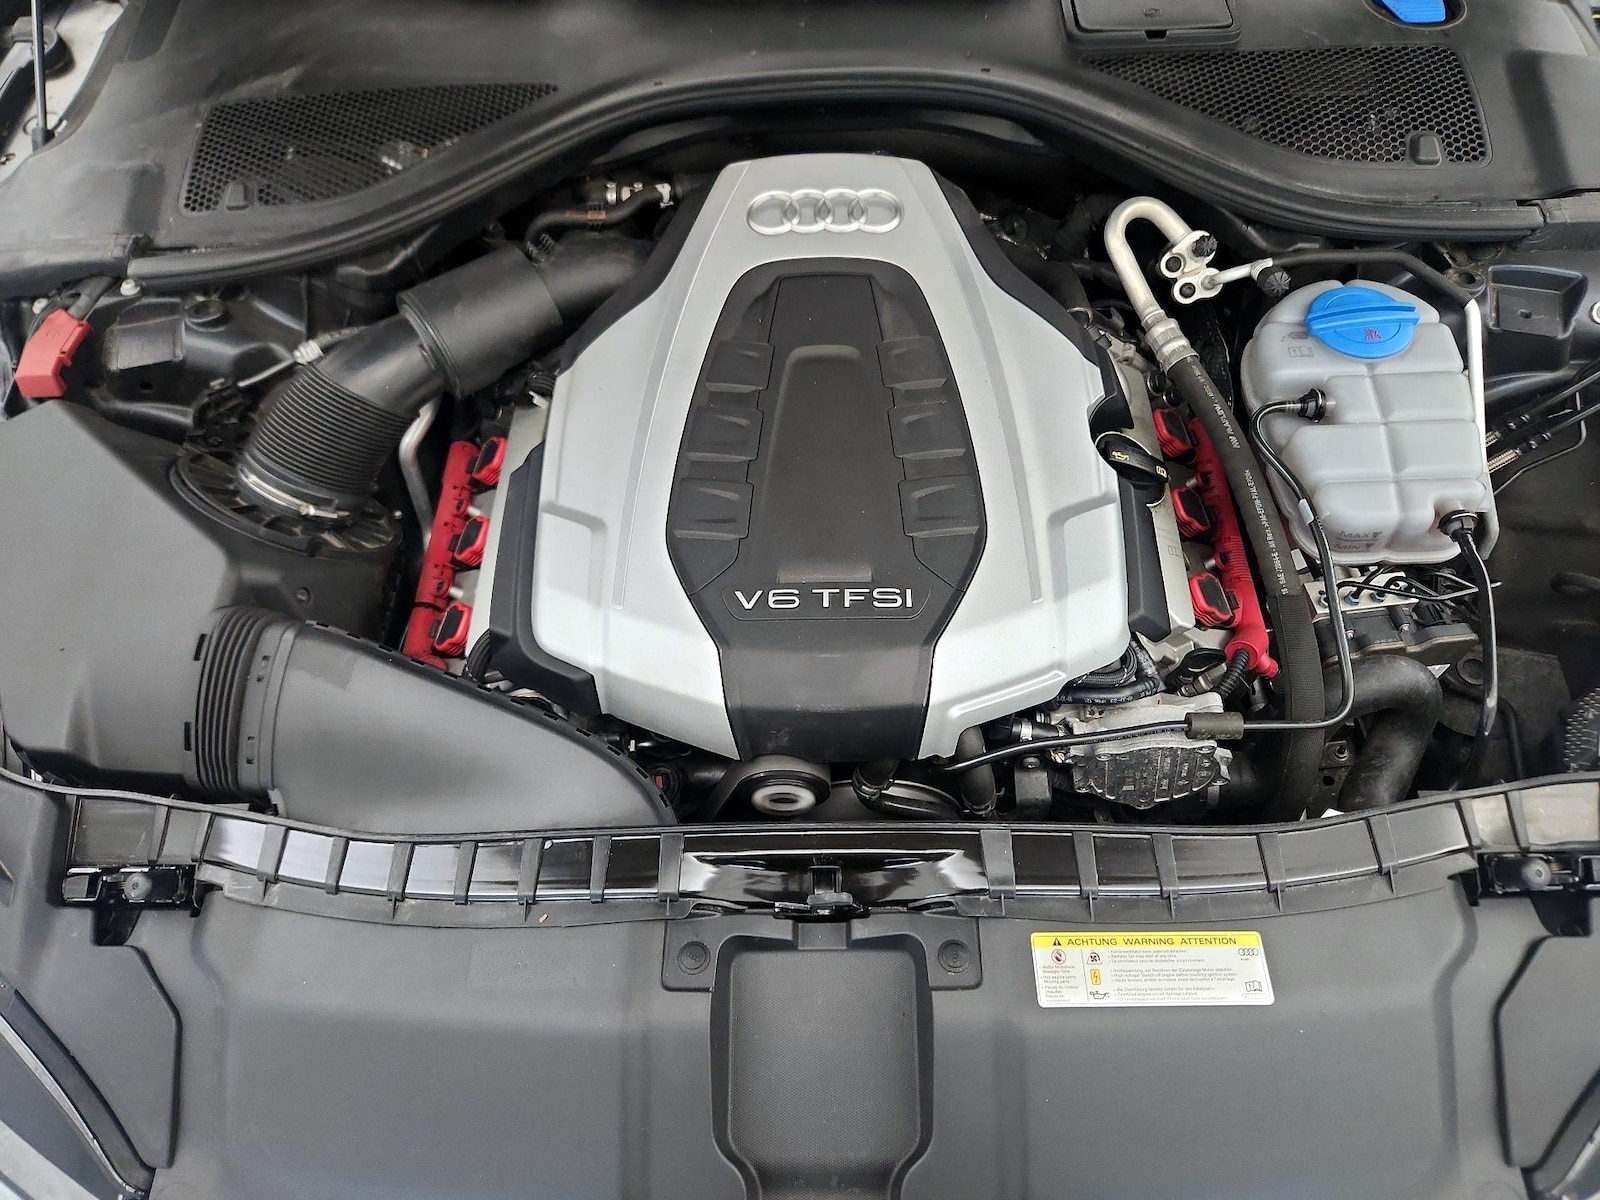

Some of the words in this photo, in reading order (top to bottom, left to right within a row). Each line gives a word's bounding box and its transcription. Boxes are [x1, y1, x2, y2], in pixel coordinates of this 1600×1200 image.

[734, 589, 800, 609] V6
[812, 587, 913, 608] TFSI
[1067, 938, 1118, 946] ACHTUNG
[1180, 937, 1237, 945] ATTENTION
